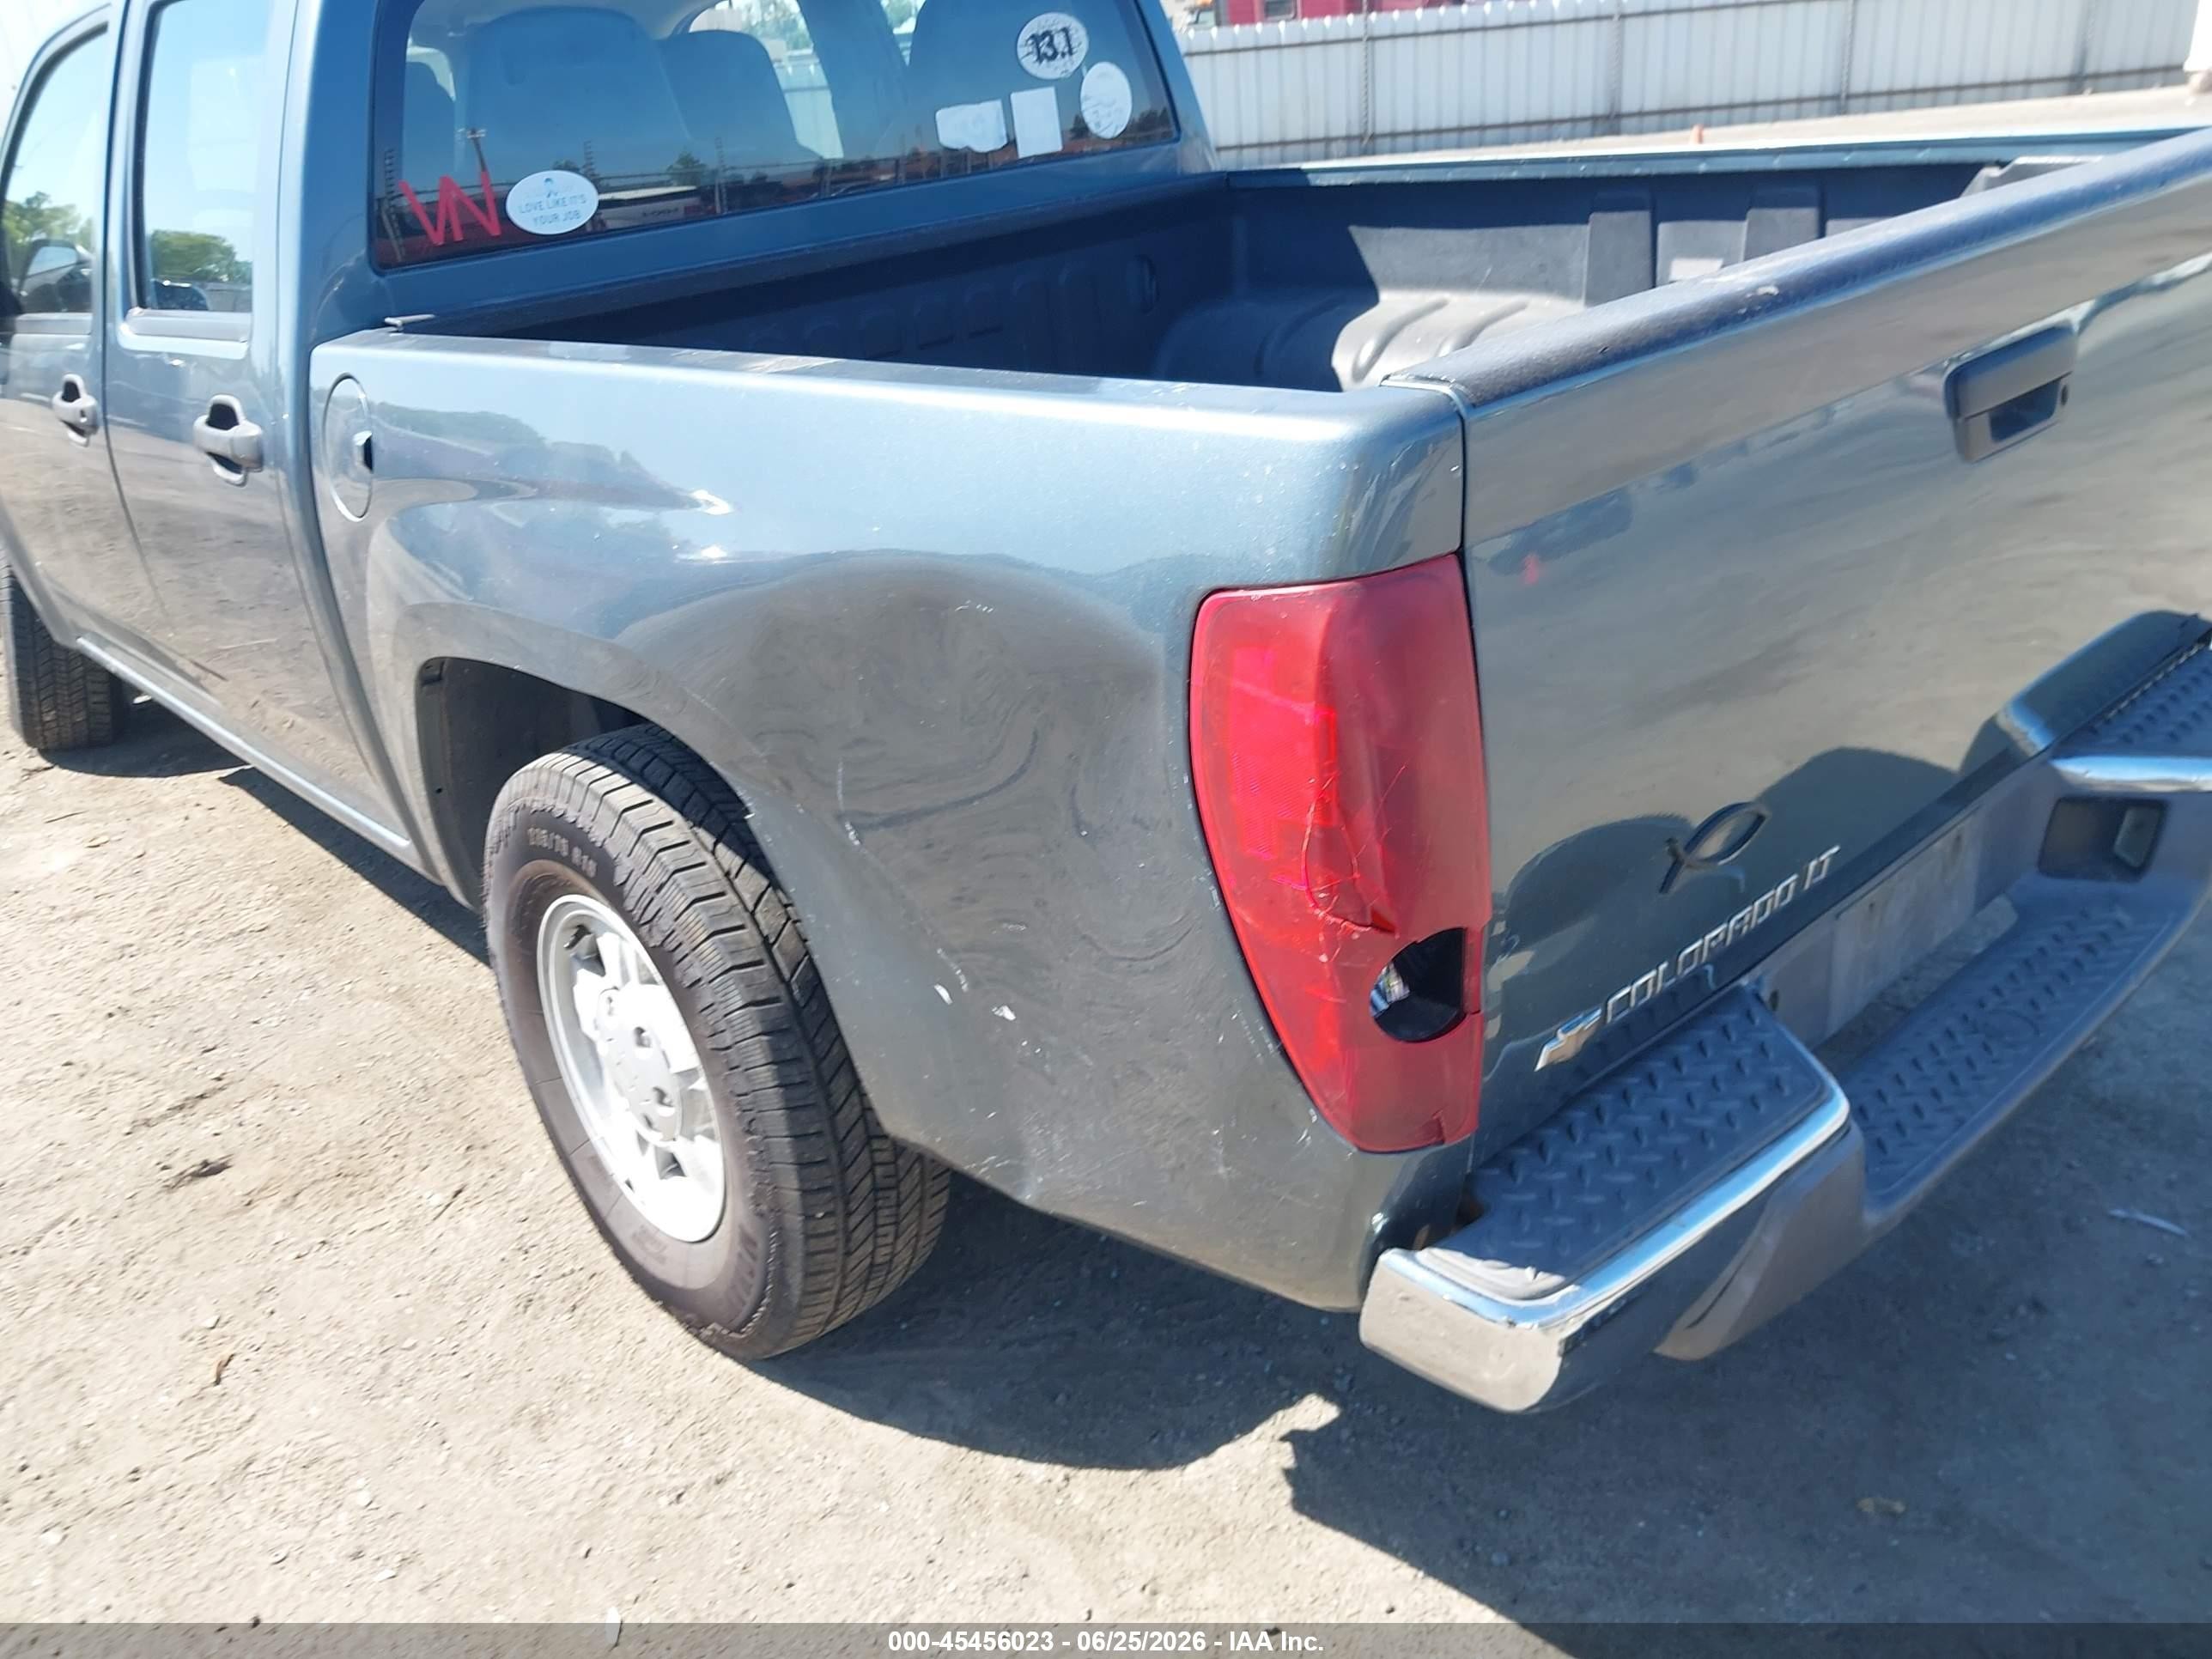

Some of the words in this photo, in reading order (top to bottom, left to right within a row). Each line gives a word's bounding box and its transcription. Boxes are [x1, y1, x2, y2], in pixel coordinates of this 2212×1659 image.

[1024, 27, 1073, 64] 13.1
[518, 200, 544, 213] LOVE
[546, 197, 568, 209] LIKE
[532, 212, 560, 226] YOUR
[562, 210, 580, 222] JOB
[1605, 872, 1800, 1024] COLORADO
